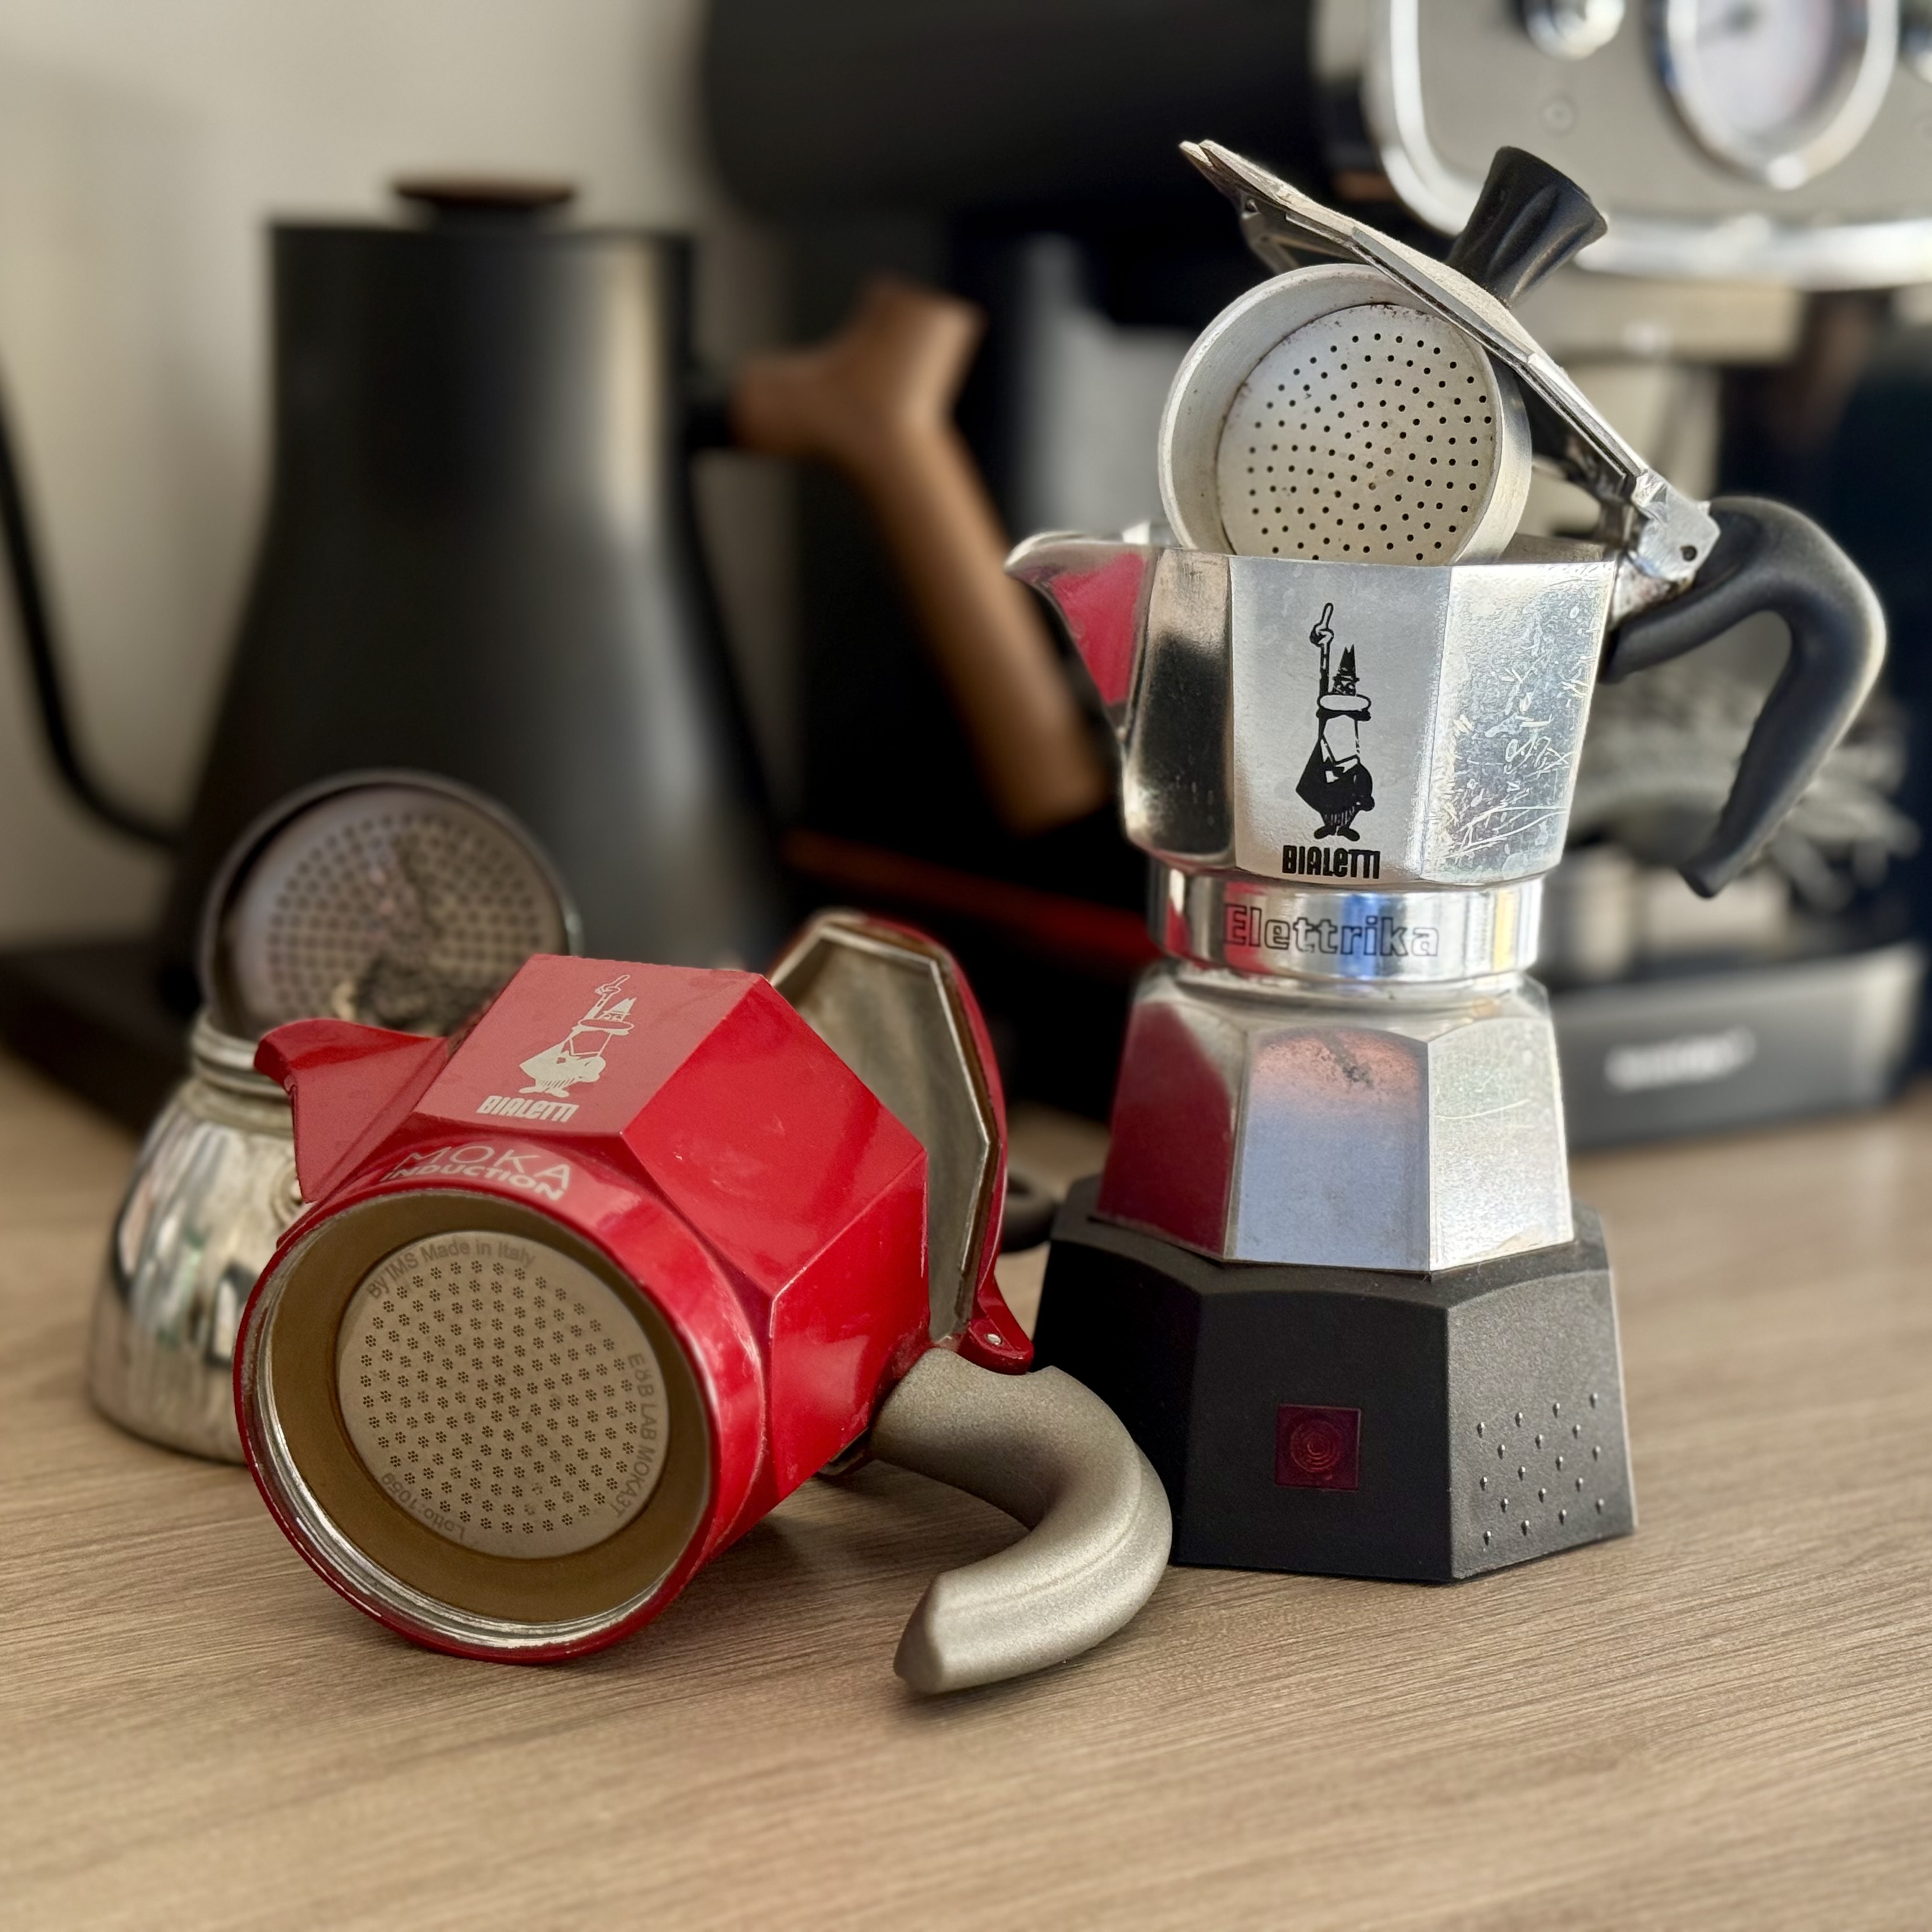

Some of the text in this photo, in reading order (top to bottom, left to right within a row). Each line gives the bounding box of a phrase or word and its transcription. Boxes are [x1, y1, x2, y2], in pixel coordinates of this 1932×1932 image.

[1224, 904, 1439, 956] Elettrika
[379, 1164, 564, 1200] INDUCTION
[393, 1146, 571, 1190] MOKA
[367, 1239, 536, 1300] By IMS Made in Italy
[640, 1404, 657, 1440] LAB
[610, 1445, 656, 1518] MOKA3T
